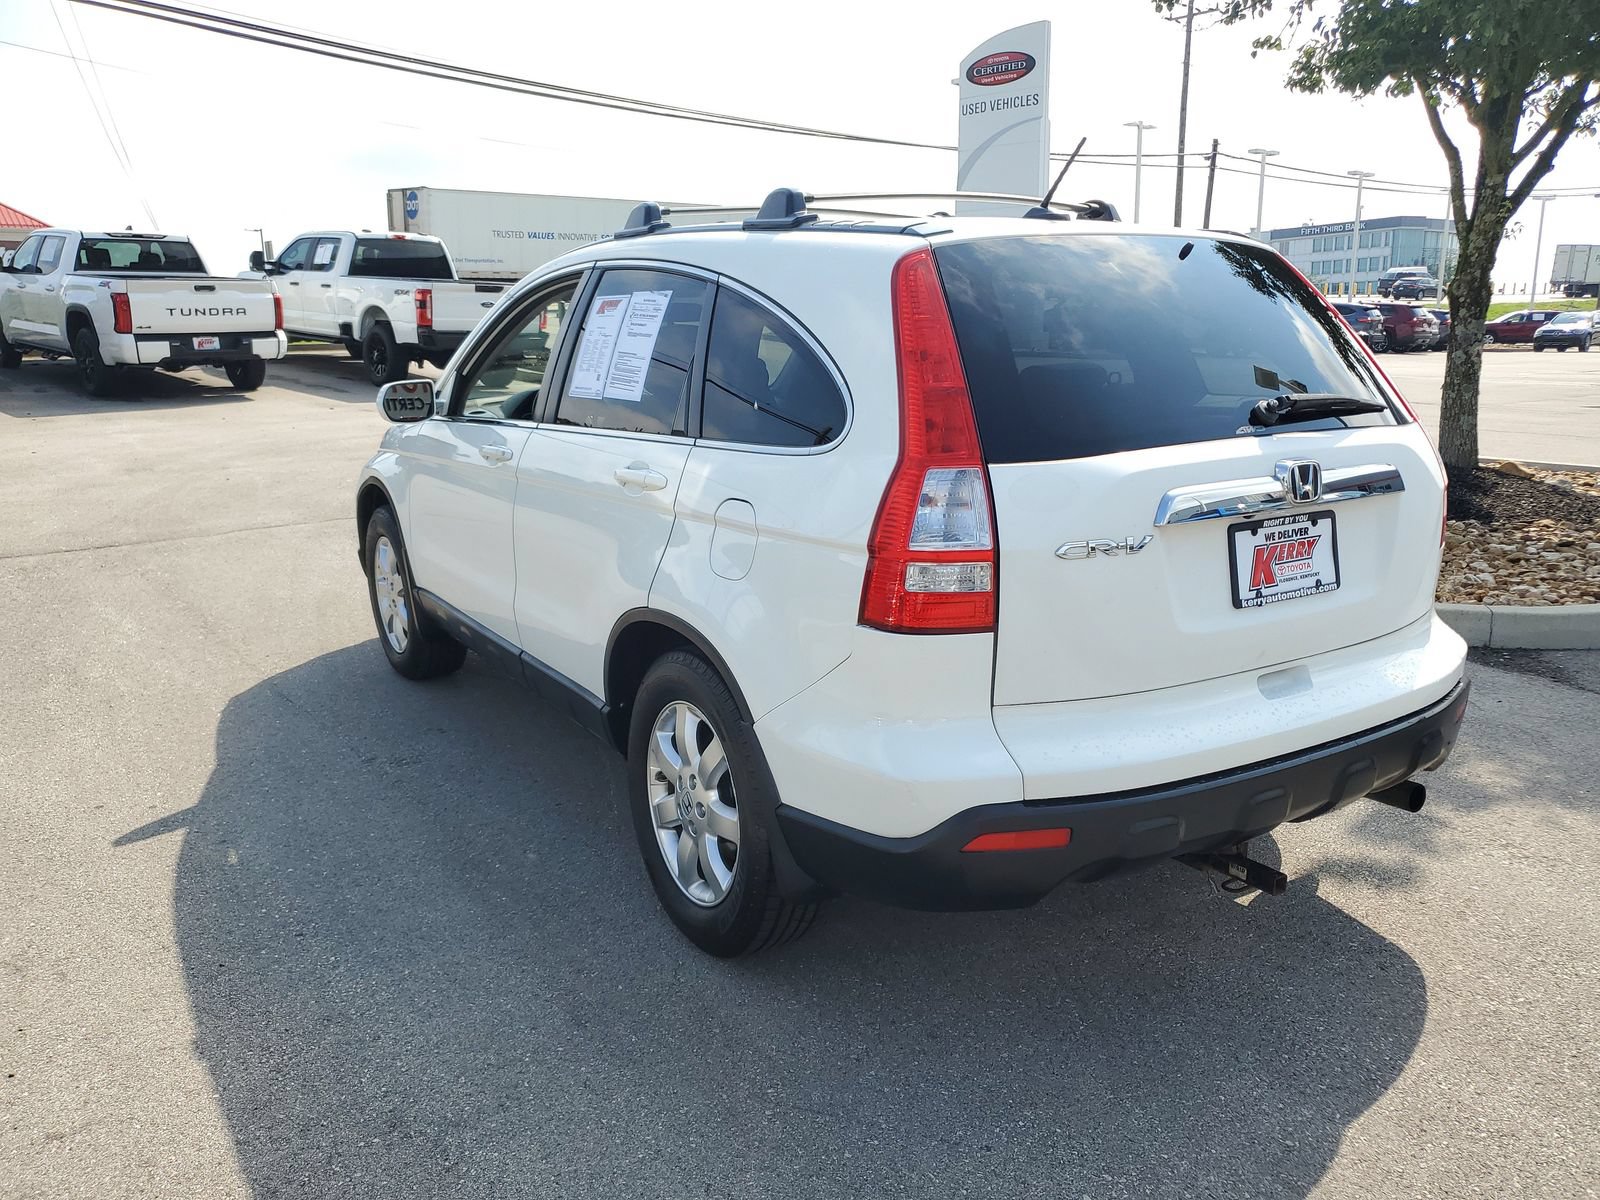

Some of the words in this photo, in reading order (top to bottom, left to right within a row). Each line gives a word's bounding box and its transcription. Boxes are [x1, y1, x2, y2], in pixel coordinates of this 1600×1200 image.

[973, 61, 1026, 76] CERTIFIED
[994, 73, 1017, 81] Vehicles
[961, 101, 986, 116] USED
[989, 93, 1039, 112] VEHICLES
[492, 230, 525, 239] TRUSTED
[557, 232, 598, 242] INNOVATIVE
[1300, 227, 1320, 236] FIFTH
[1322, 225, 1344, 233] THIRD
[1345, 222, 1366, 231] BAK
[165, 307, 247, 317] TUNDRA
[1263, 517, 1284, 528] RIGHT
[1284, 515, 1295, 524] BY
[1295, 514, 1309, 523] YOU
[1264, 532, 1276, 543] WE
[1277, 527, 1309, 540] DELIVER
[1055, 535, 1154, 560] CR-V
[1249, 534, 1322, 592] KERRY
[1286, 562, 1312, 573] TOYOTA
[1241, 583, 1337, 608] kerryautomotive.com
